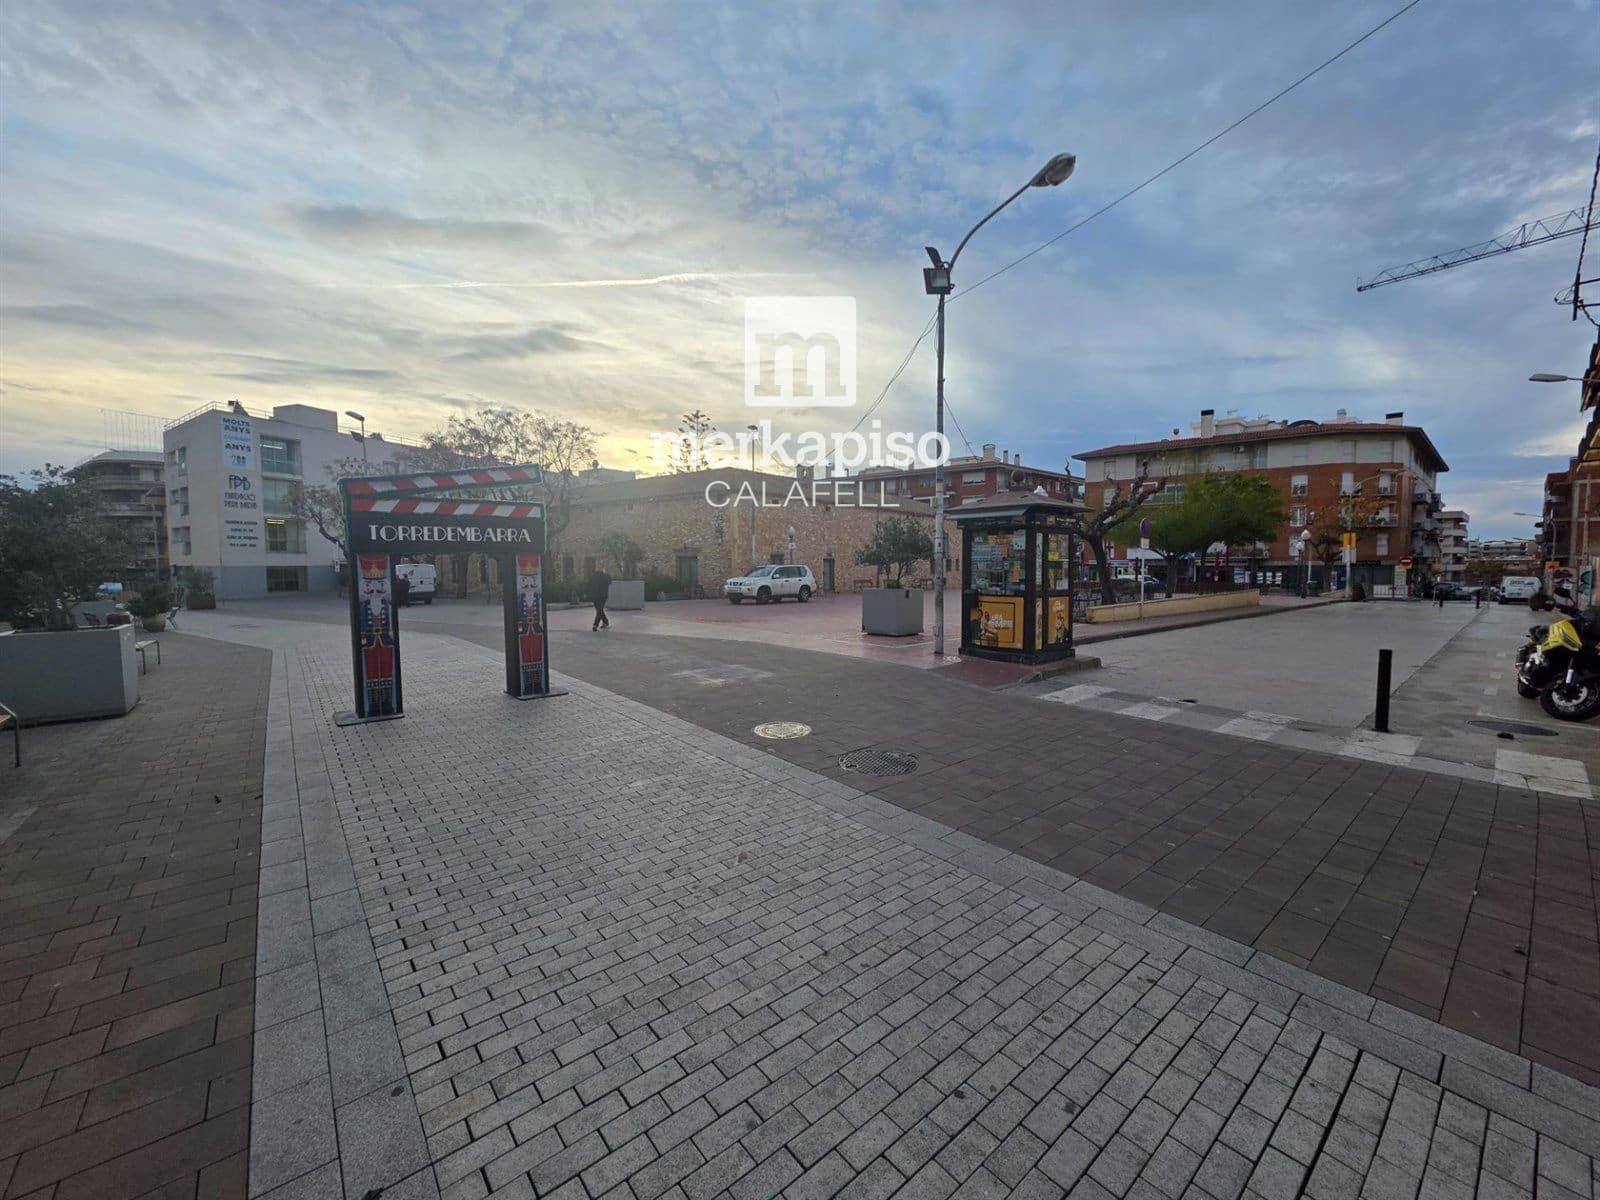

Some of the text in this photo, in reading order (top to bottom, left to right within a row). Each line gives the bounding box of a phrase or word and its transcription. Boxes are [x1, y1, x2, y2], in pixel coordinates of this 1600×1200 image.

[222, 418, 250, 427] MOLTS
[224, 424, 251, 434] ANYS
[225, 442, 251, 452] ANYS
[369, 524, 532, 543] TORREDEMBARRA
